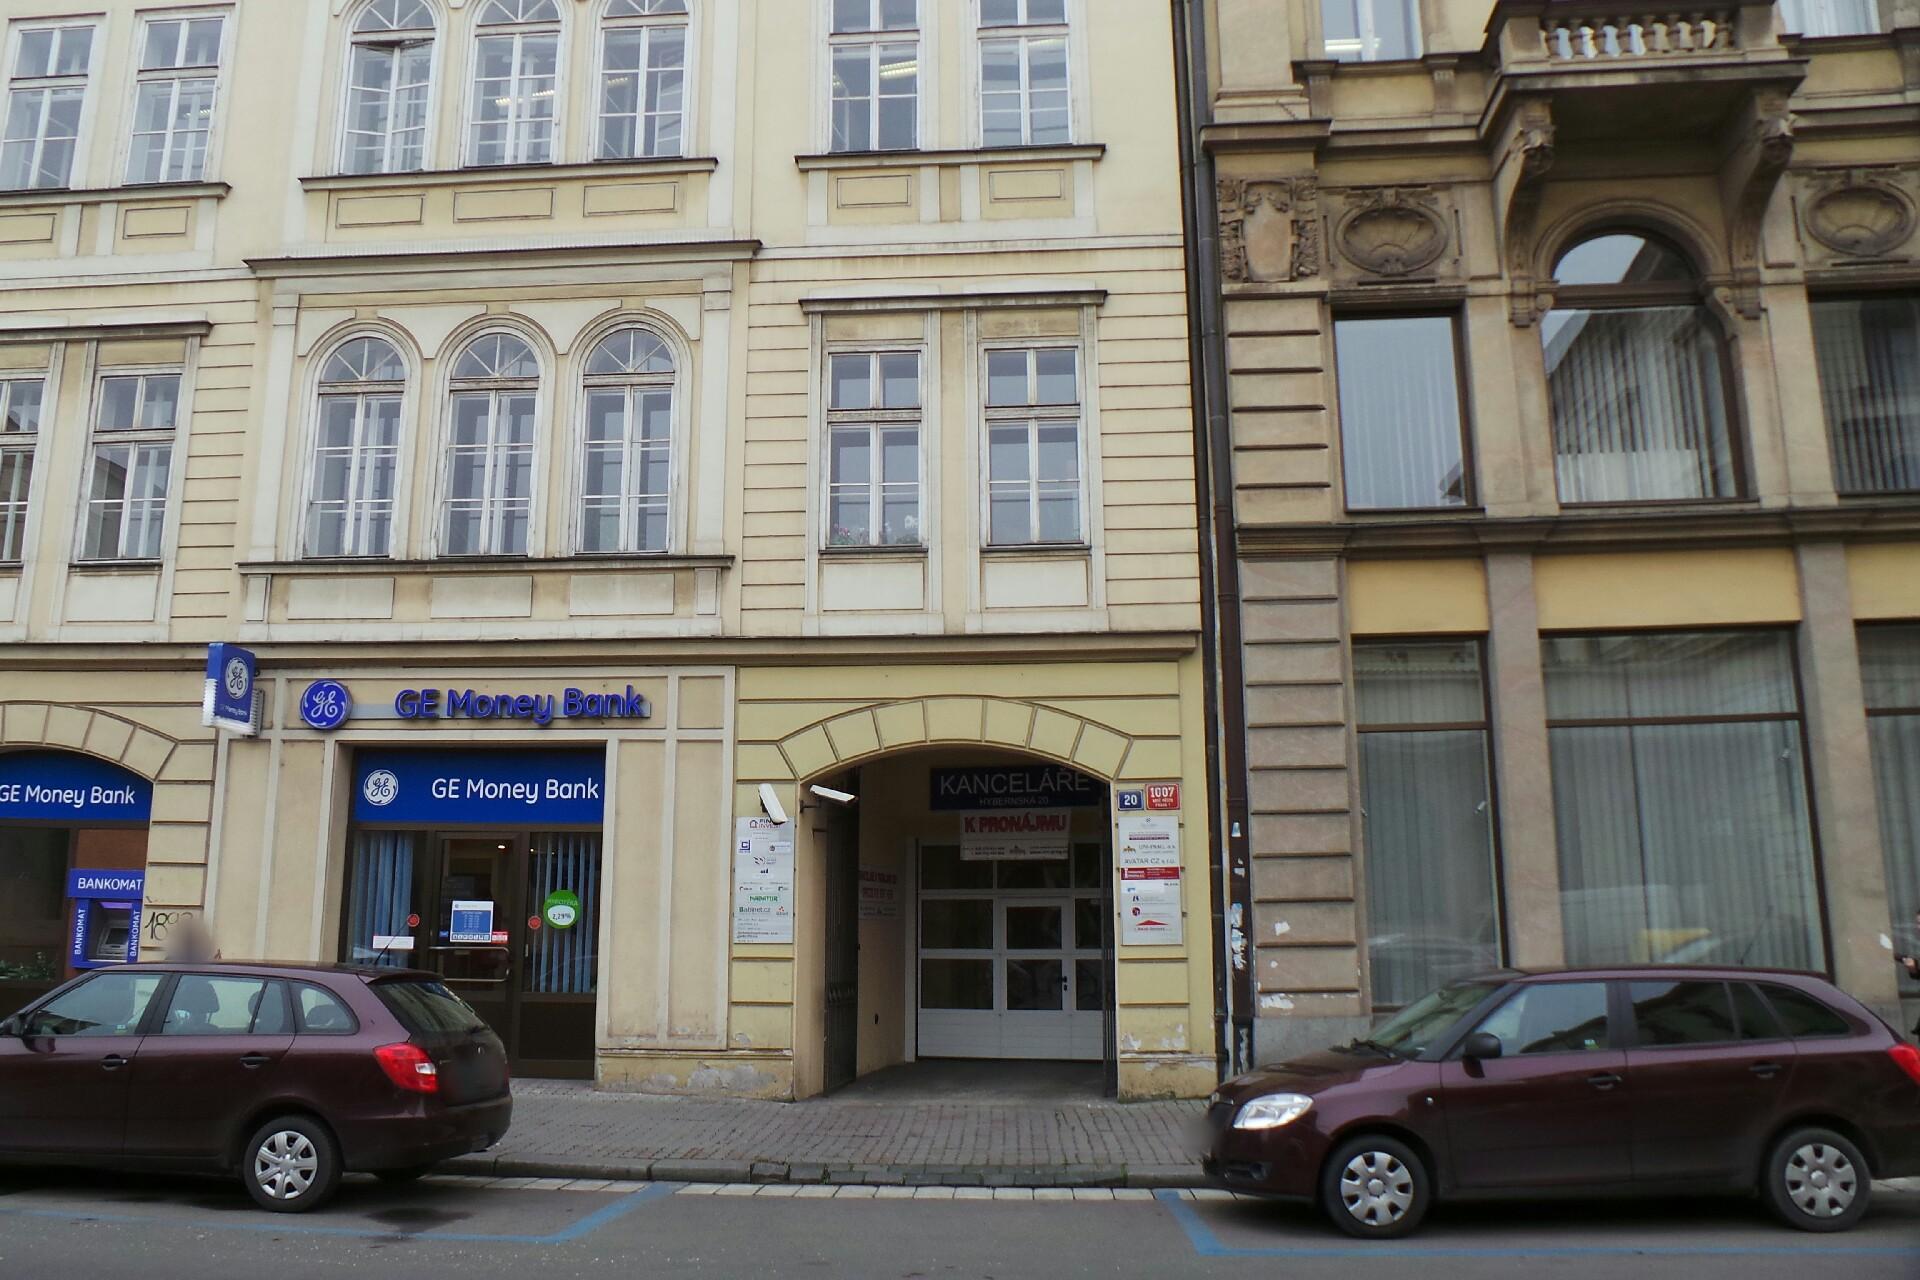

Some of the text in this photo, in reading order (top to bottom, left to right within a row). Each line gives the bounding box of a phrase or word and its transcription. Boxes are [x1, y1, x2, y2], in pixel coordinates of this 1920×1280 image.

[395, 684, 643, 727] GE Money Bank
[431, 777, 600, 804] GE Money Bank
[940, 768, 1090, 795] KANCELÁŘE
[1150, 787, 1174, 798] 1007
[0, 784, 136, 809] GE Money Bank
[1124, 794, 1138, 806] 20
[964, 811, 1067, 833] K PRONÁJMU
[77, 878, 143, 891] BANKOMAT
[74, 909, 86, 955] BANKOMAT
[129, 910, 141, 957] BANKOMAT
